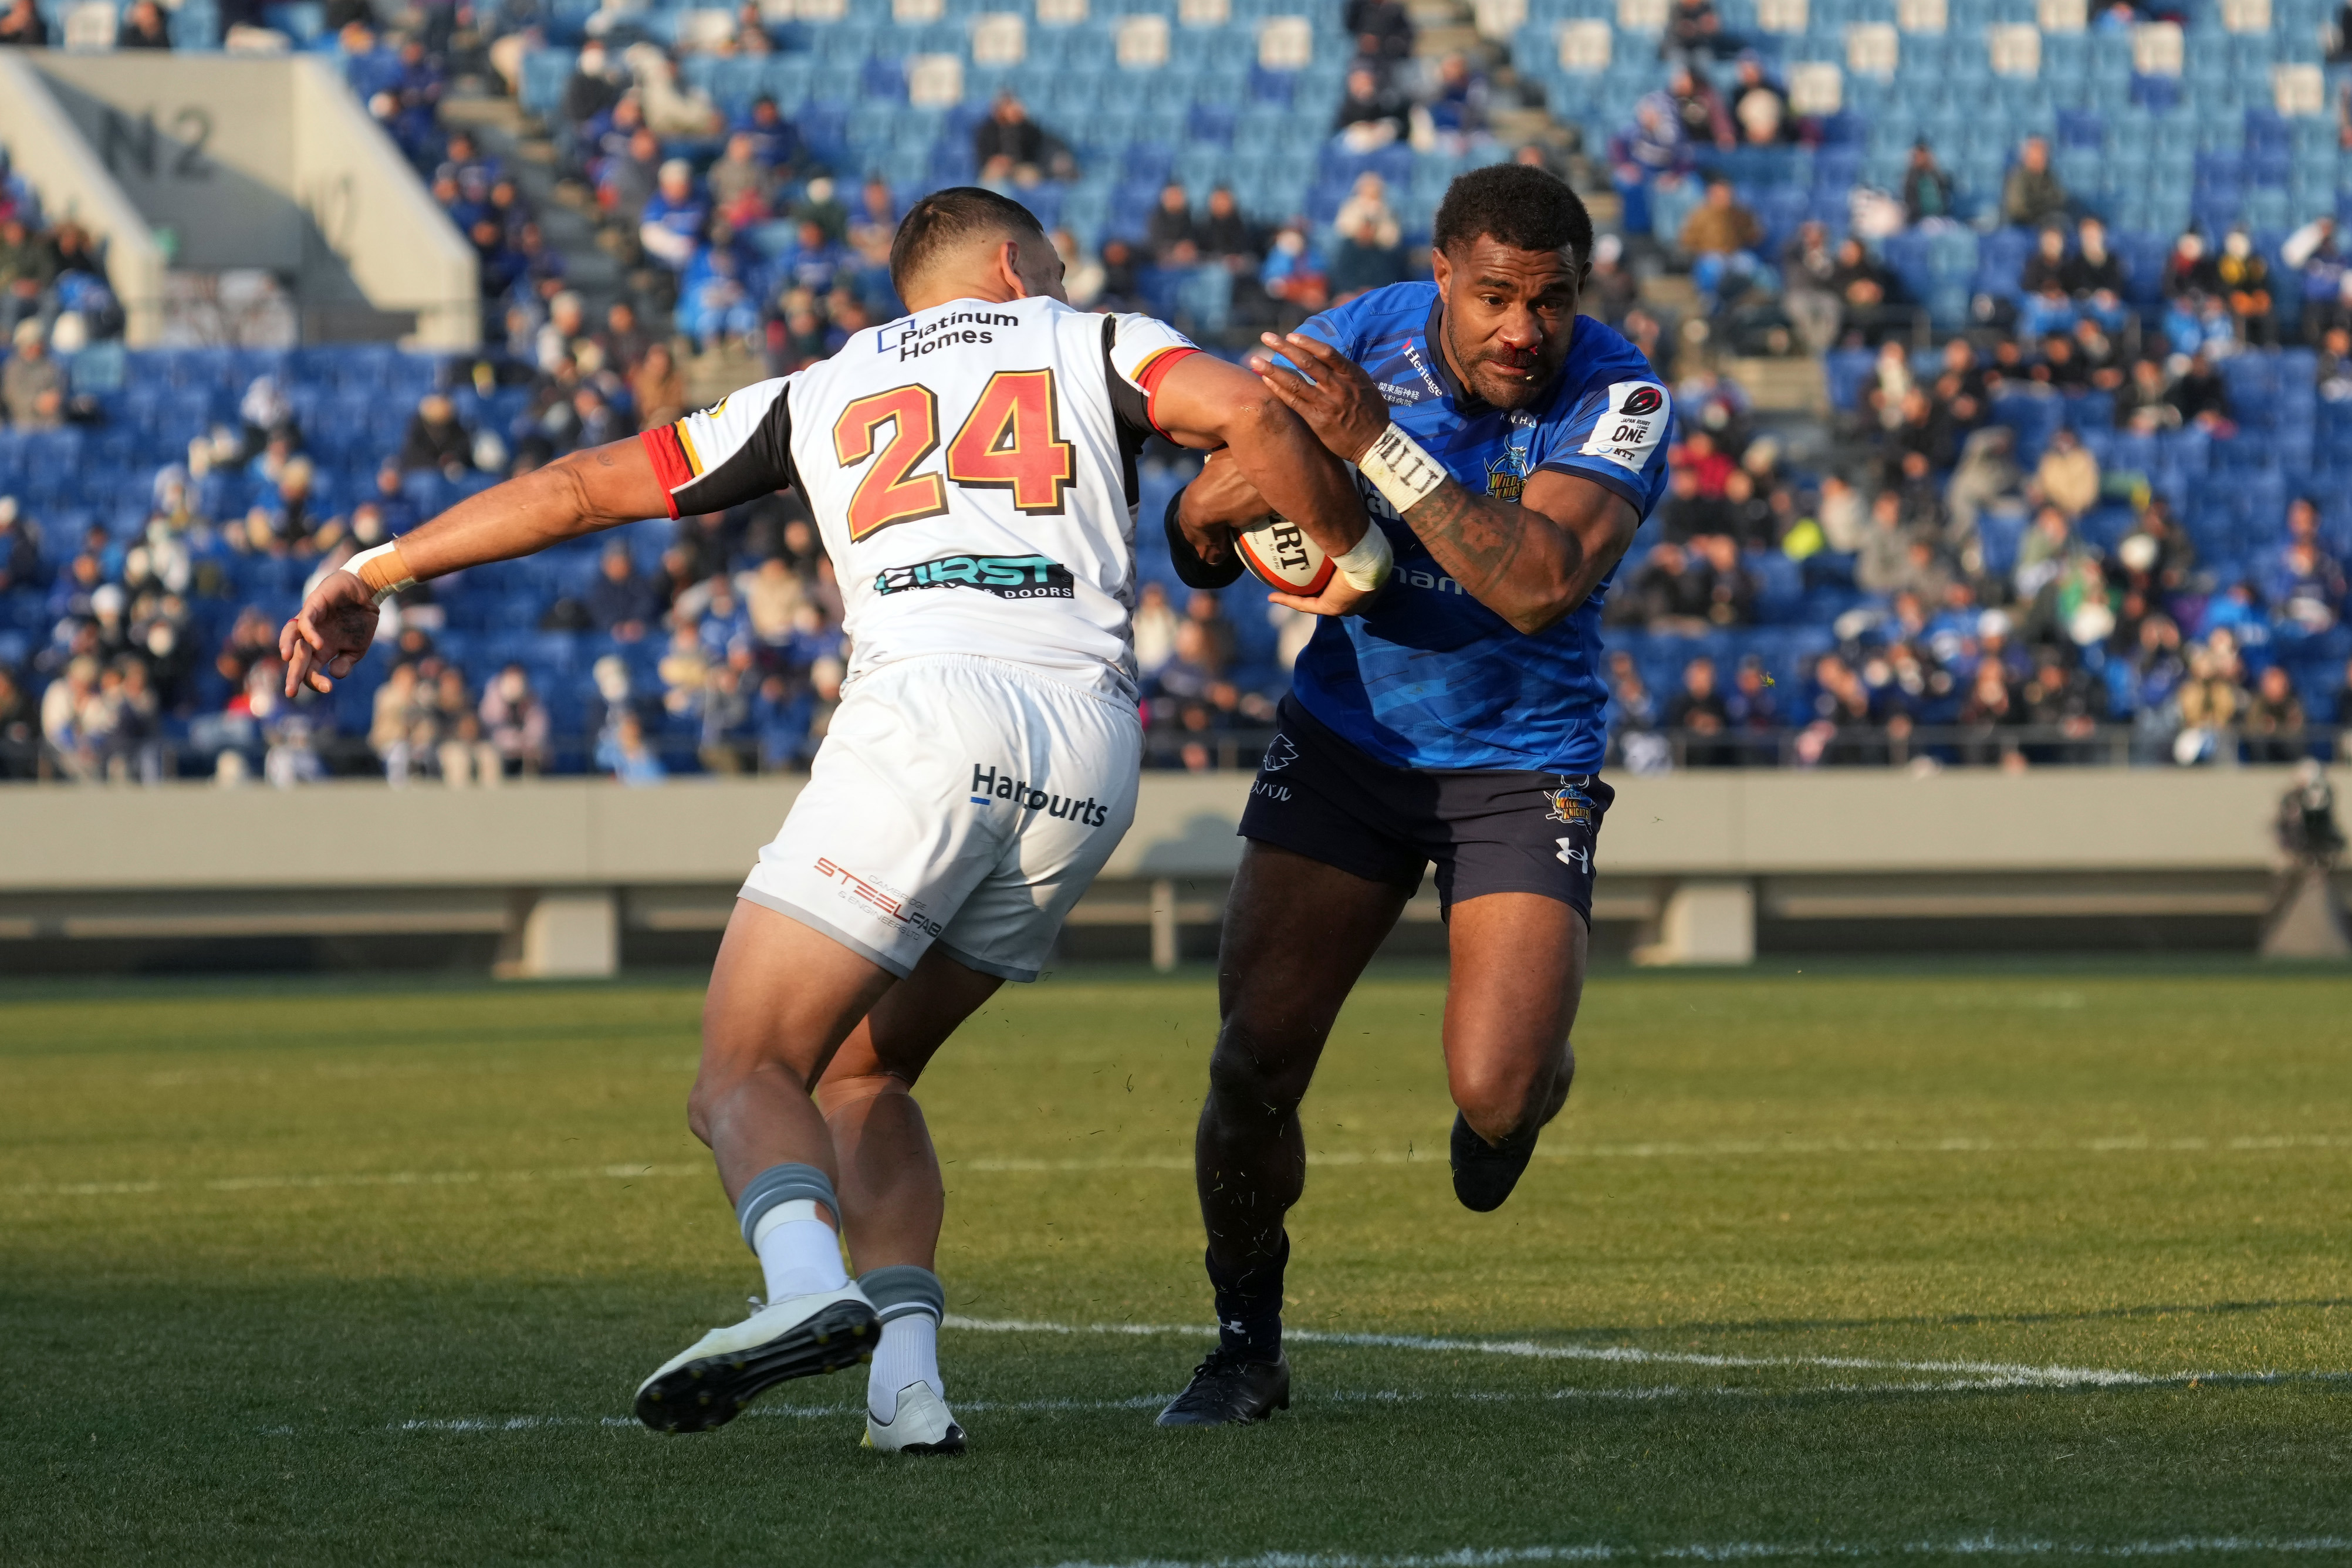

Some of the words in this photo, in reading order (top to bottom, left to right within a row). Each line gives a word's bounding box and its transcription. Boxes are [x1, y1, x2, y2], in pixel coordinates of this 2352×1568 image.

[900, 312, 1018, 346] Platinum
[900, 330, 992, 362] Homes
[1403, 345, 1442, 397] Heritage
[1378, 381, 1420, 400] 関東脳神経
[1611, 425, 1647, 444] ONE
[832, 366, 1076, 545] 24
[1613, 448, 1635, 461] NTT
[1489, 473, 1518, 489] WILD
[1005, 587, 1073, 599] DOORS
[972, 763, 1109, 827] Harcourts
[868, 874, 928, 911] CAMBRIDGE
[838, 890, 847, 898] &
[848, 895, 907, 934] ENGINEERS
[906, 928, 921, 941] LTD
